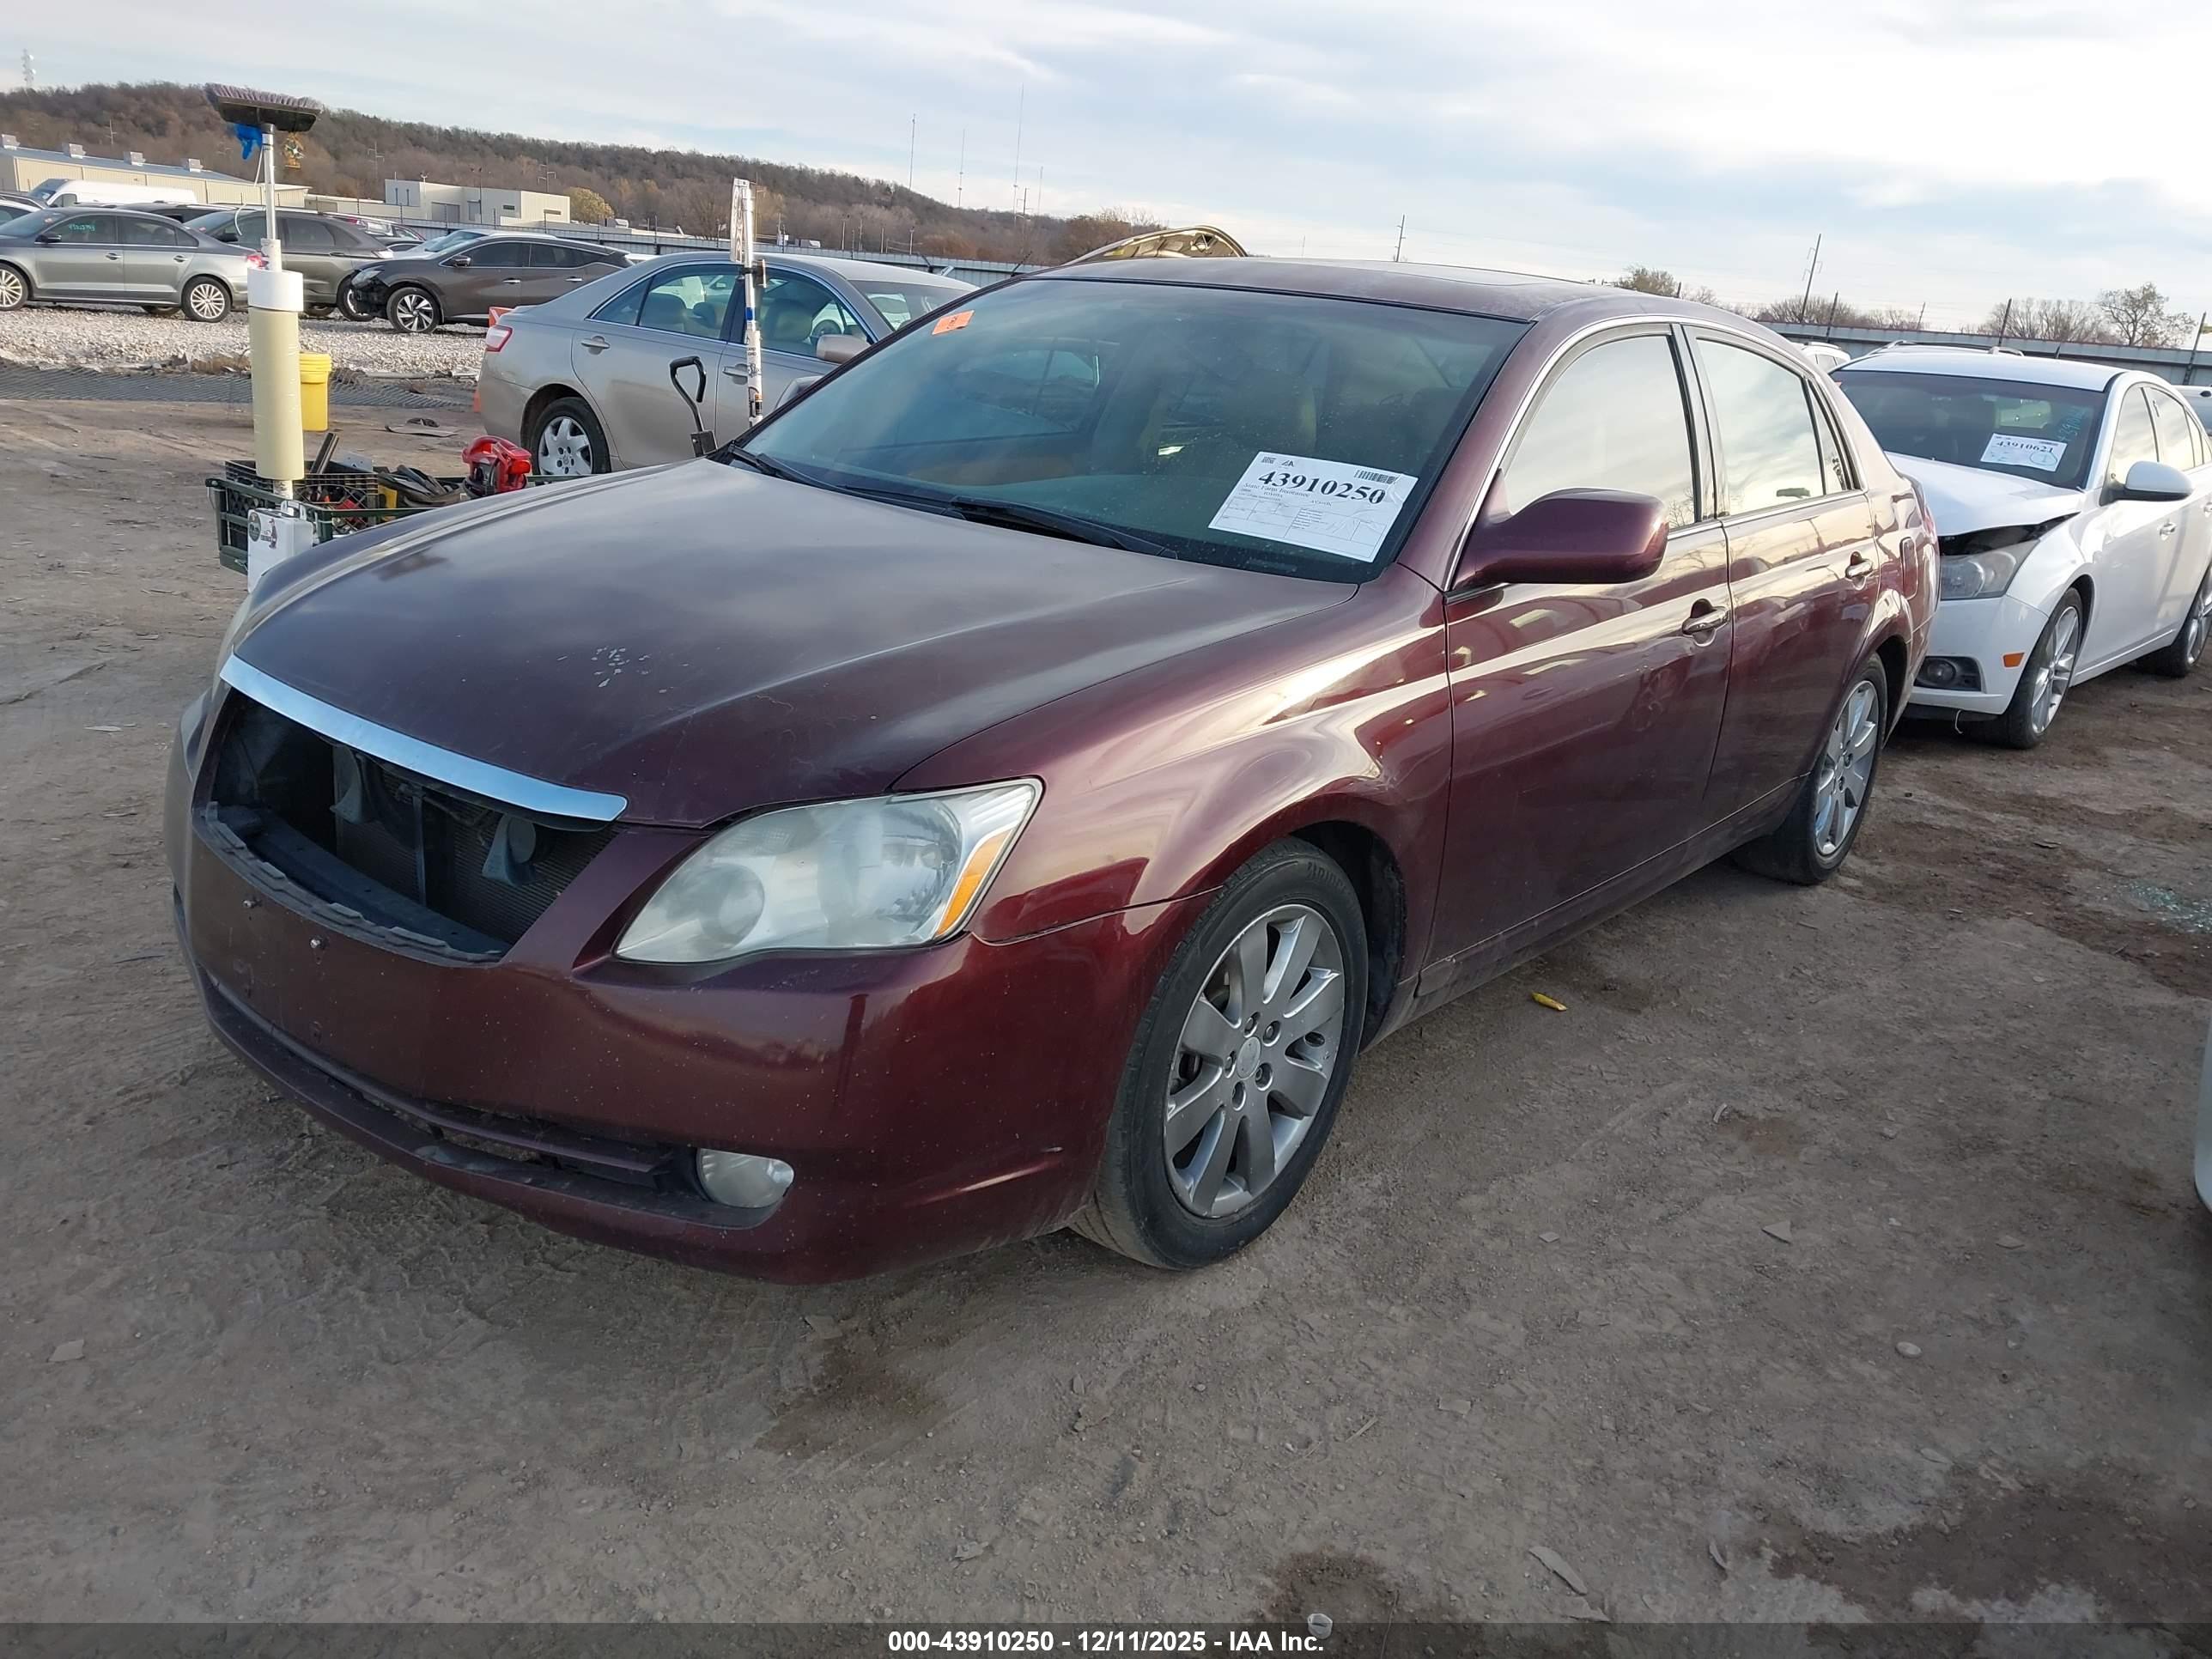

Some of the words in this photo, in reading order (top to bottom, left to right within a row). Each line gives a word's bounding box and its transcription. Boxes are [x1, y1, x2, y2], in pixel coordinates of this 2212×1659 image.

[1996, 441, 2053, 453] 43910621
[1258, 471, 1386, 504] 43910250
[1279, 488, 1310, 497] Insurance
